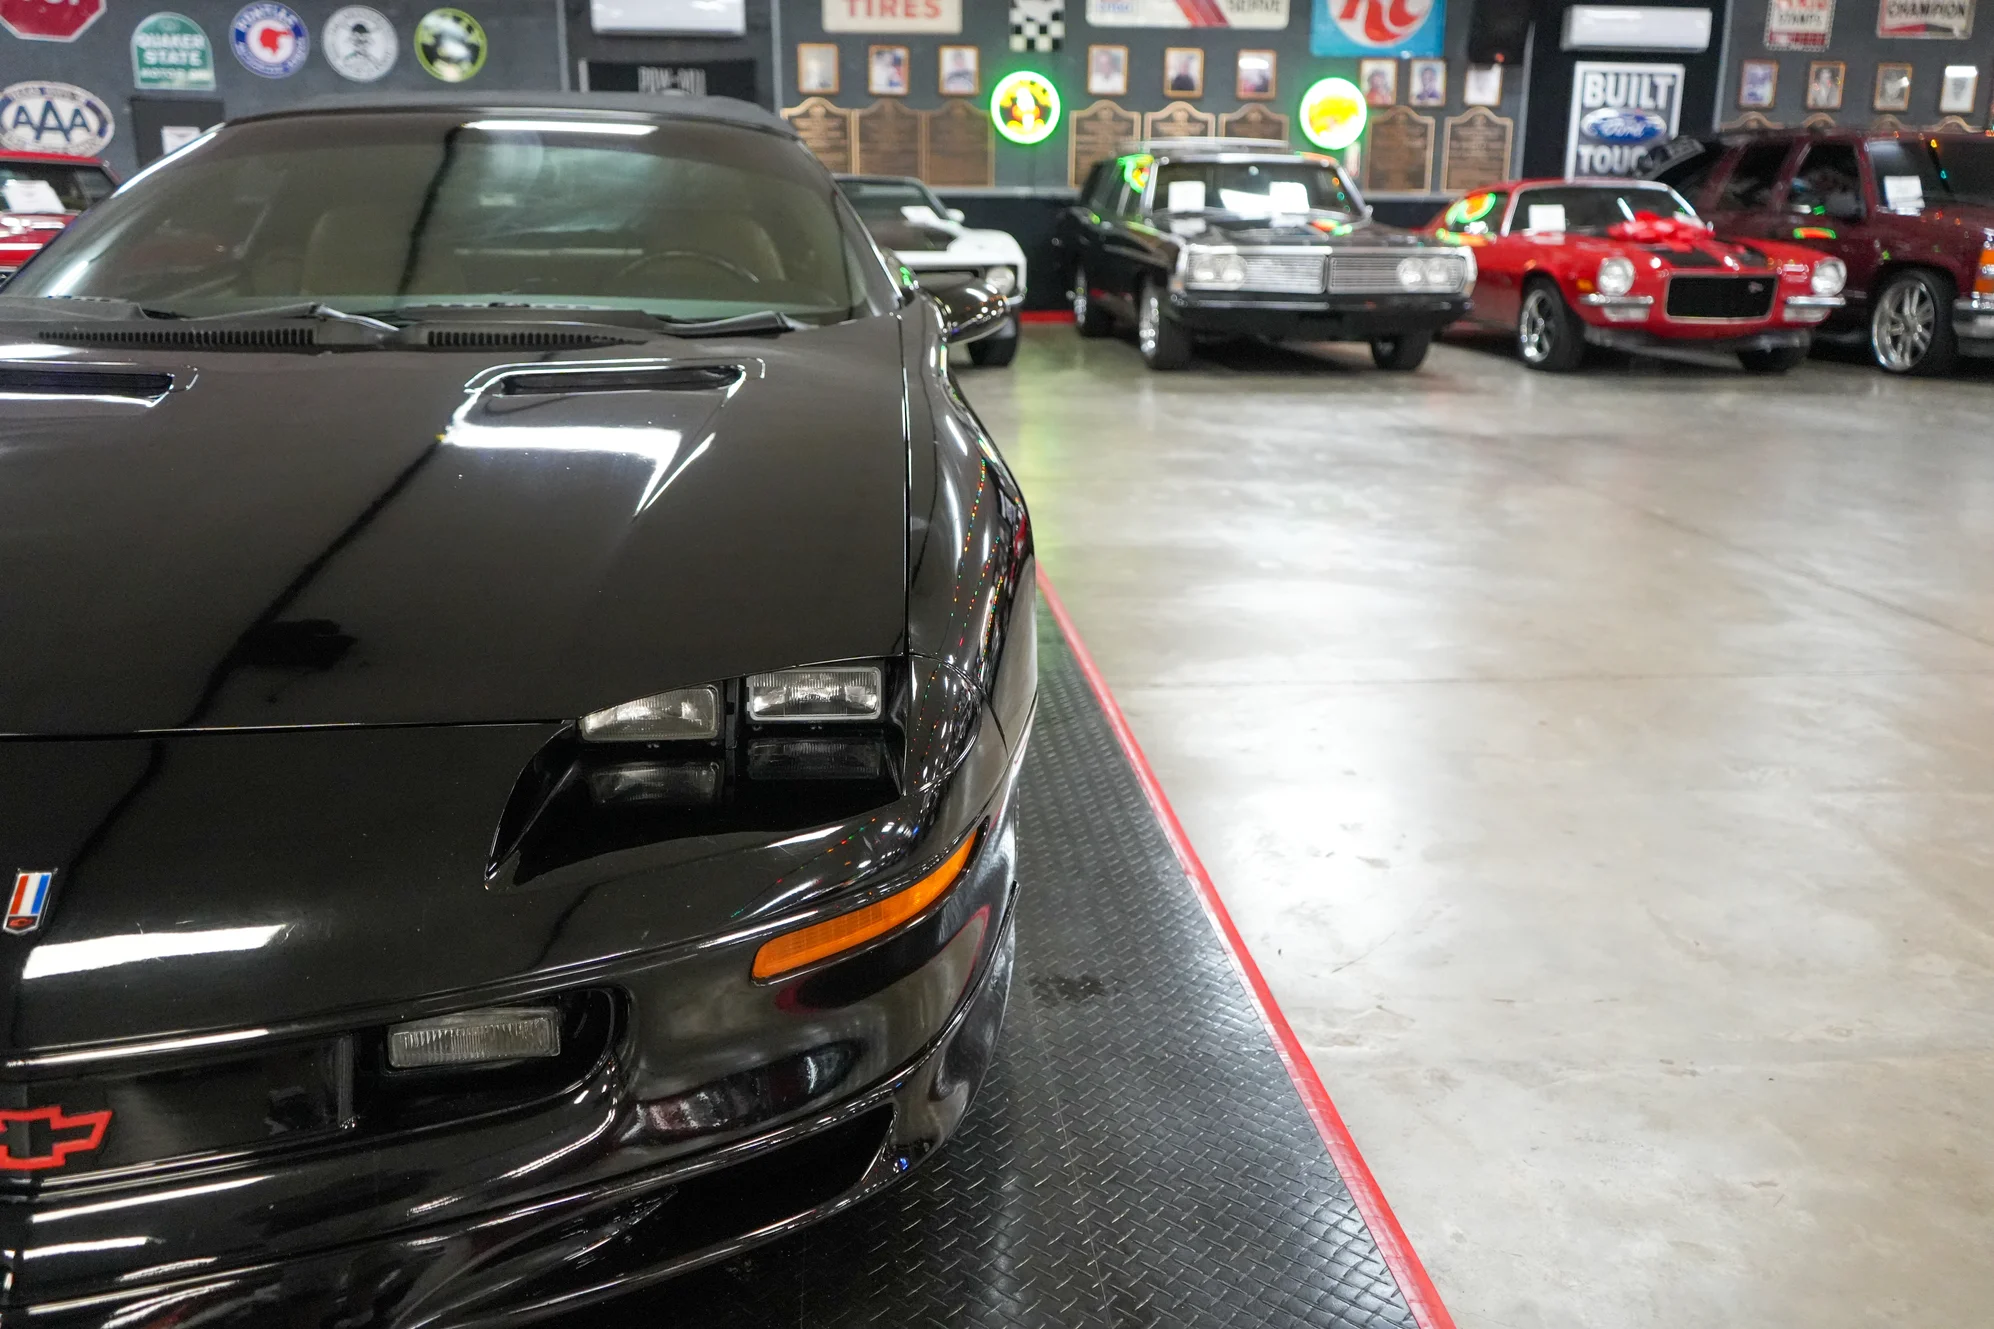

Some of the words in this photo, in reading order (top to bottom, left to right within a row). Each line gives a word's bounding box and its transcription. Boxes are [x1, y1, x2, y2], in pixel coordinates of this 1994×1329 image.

[845, 0, 942, 18] TIRES
[1886, 1, 1966, 18] CHAMPION
[138, 33, 206, 49] QUAKER
[143, 50, 203, 67] STATE
[1583, 72, 1674, 109] BUILT
[12, 99, 91, 142] AAA
[1600, 117, 1646, 138] Ford
[1578, 145, 1651, 174] TOU
